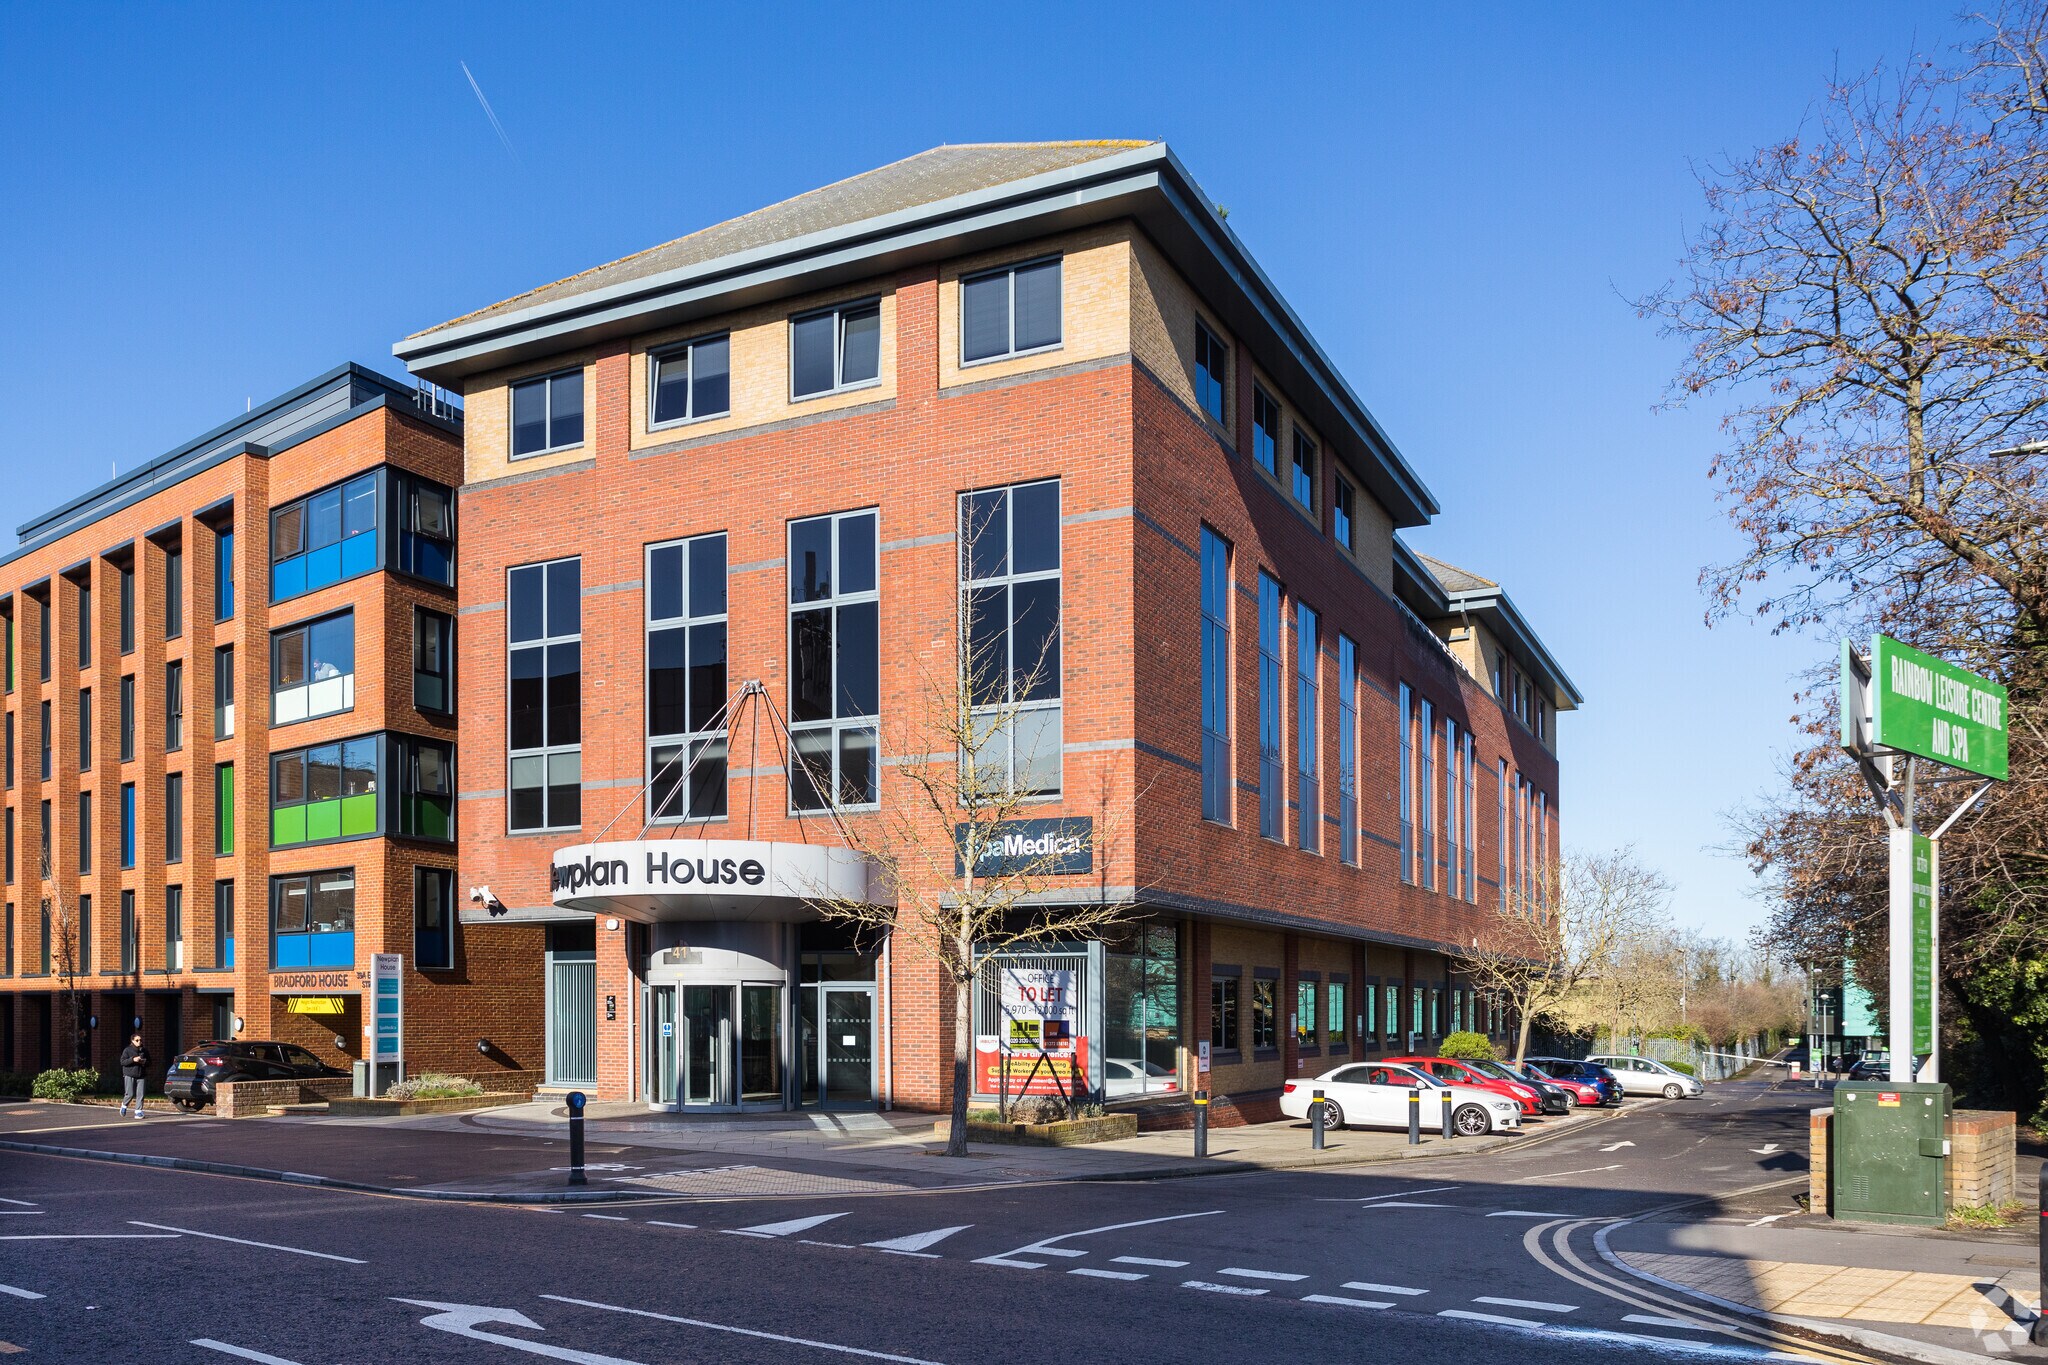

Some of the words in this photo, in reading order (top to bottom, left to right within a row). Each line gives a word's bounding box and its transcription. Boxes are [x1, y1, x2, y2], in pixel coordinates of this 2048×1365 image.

[1891, 654, 1933, 706] RAINBOW
[1935, 672, 1970, 720] LEISURE
[1971, 687, 2002, 731] CENTRE
[1932, 717, 1950, 757] AND
[1952, 724, 1969, 763] SPA
[550, 855, 628, 895] ewplan
[646, 851, 766, 886] House
[377, 955, 399, 963] Newplan
[675, 947, 687, 959] 41
[273, 975, 316, 988] BRADFORD
[319, 974, 348, 987] HOUSE
[1027, 973, 1055, 984] OFFICE
[1018, 986, 1037, 1002] TO
[1040, 986, 1063, 1002] LET
